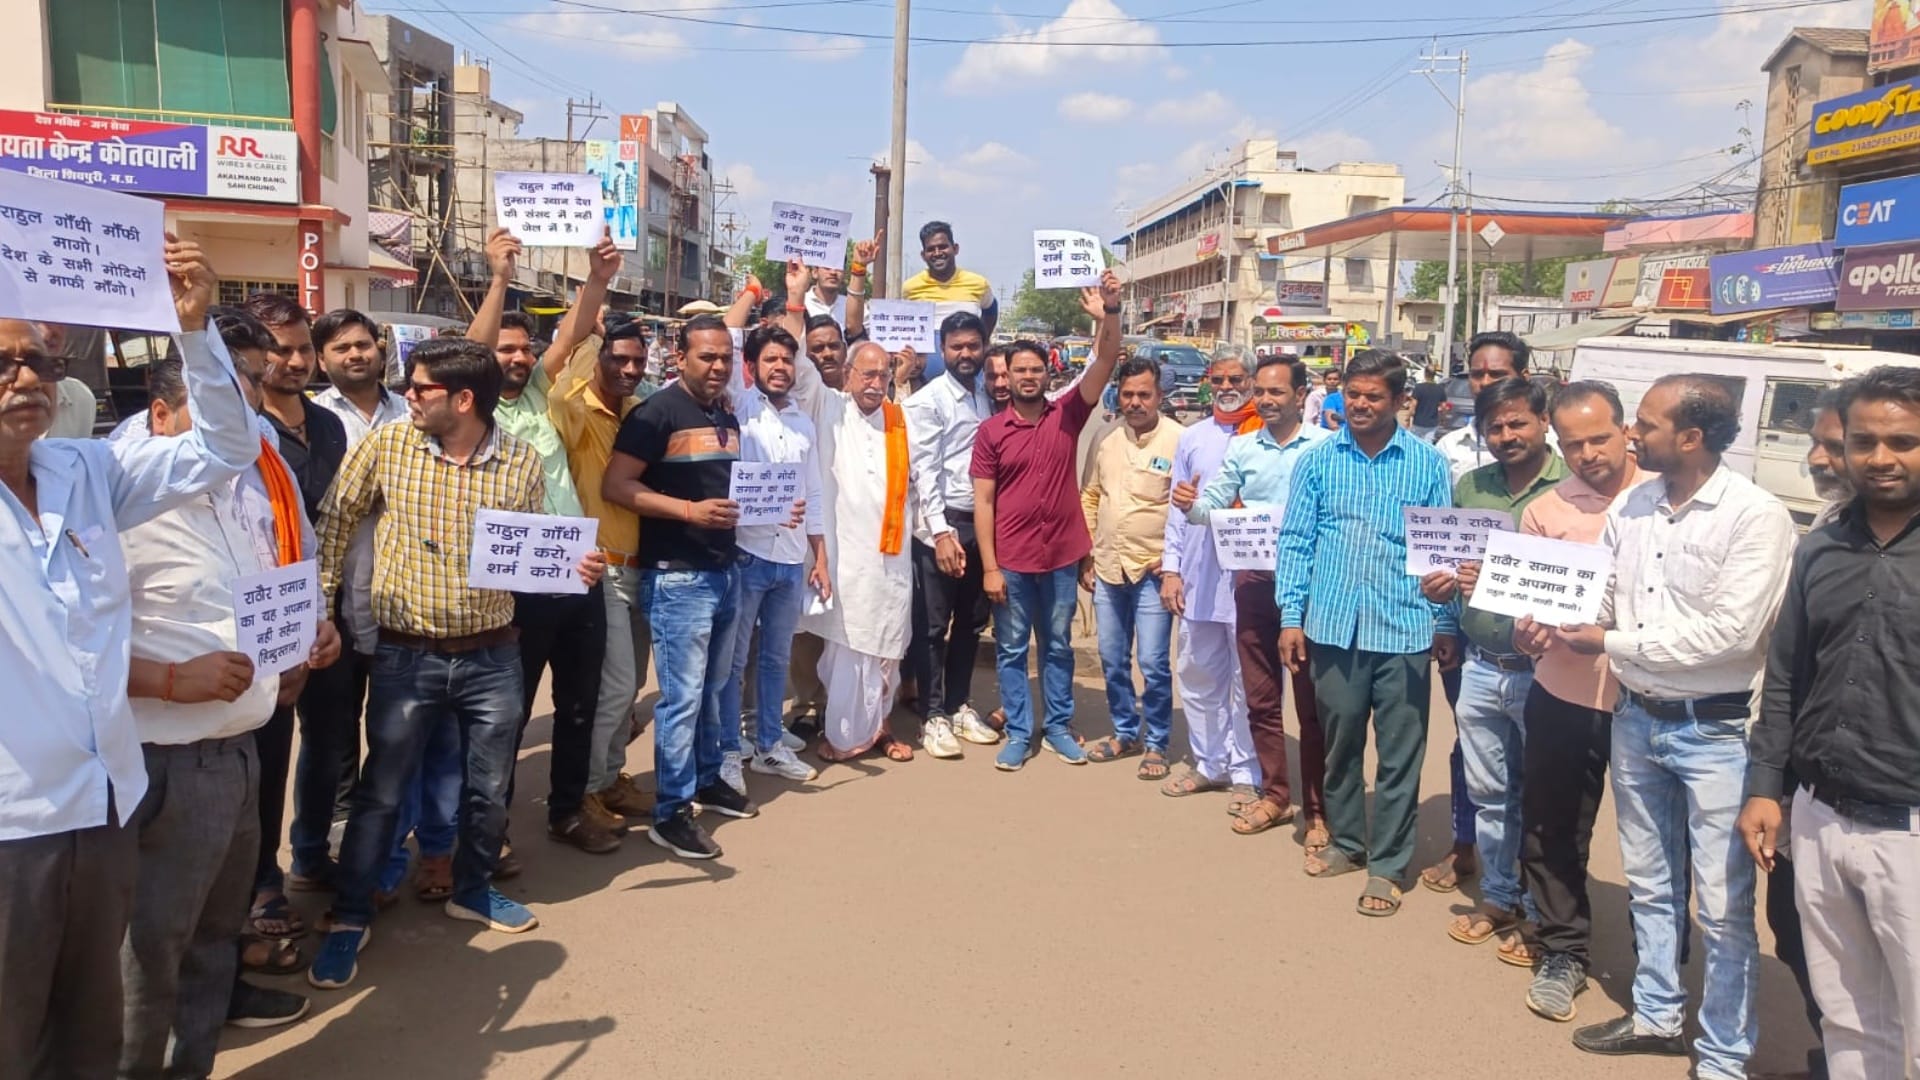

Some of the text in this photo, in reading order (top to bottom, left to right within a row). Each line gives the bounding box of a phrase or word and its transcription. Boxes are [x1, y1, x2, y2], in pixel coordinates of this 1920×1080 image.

[35, 115, 52, 124] देश
[111, 120, 130, 131] सेवा
[628, 118, 643, 133] V
[48, 131, 94, 164] केन्द्र
[99, 136, 198, 171] कोतवाली
[217, 135, 263, 158] RR
[217, 160, 244, 168] WIRES
[254, 163, 287, 171] CABLES
[217, 173, 261, 182] AKALMAND
[518, 182, 544, 193] राहुल
[502, 196, 591, 207] तुम्हारा स्थान देश
[0, 205, 43, 226] राहुल
[503, 208, 517, 218] की
[524, 209, 550, 219] संसद
[780, 209, 840, 227] राठौर समाज
[1843, 199, 1896, 226] CEAT
[522, 222, 541, 232] जेल
[773, 221, 842, 239] का यह अपमान
[1037, 239, 1065, 251] राहुल
[1, 244, 27, 262] देश
[37, 250, 53, 266] के
[62, 257, 92, 272] सभी
[1042, 251, 1062, 262] शर्म
[301, 232, 319, 316] POLI
[1042, 264, 1062, 276] शर्म
[23, 267, 38, 283] से
[48, 274, 85, 290] माफी
[1570, 289, 1595, 302] MRF
[737, 469, 754, 480] देश
[760, 470, 772, 480] की
[1410, 512, 1503, 529] देश की राठौर
[486, 522, 530, 540] राहुल
[1410, 529, 1451, 540] समाज
[1459, 533, 1476, 542] का
[490, 542, 523, 557] शर्म
[1413, 543, 1447, 553] अपमान
[487, 561, 519, 576] शर्म
[1490, 553, 1596, 581] राठौर समाज का
[244, 578, 307, 605] राठौर समाज
[1490, 572, 1586, 598] यह अपमान है
[240, 599, 312, 628] का यह अपमान
[279, 621, 301, 638] सहेगा
[258, 638, 301, 667] (हिन्दुस्तान)
